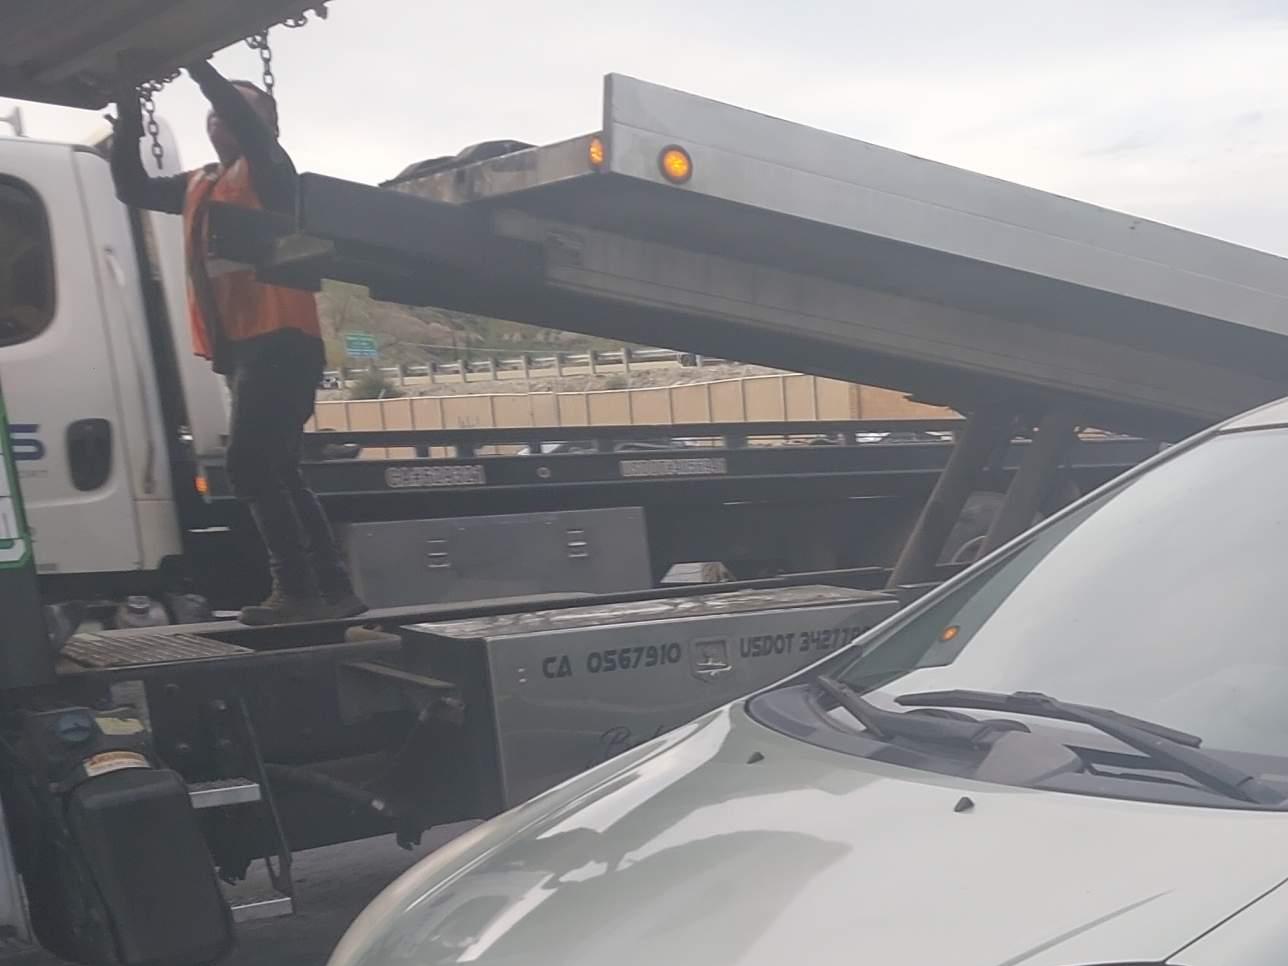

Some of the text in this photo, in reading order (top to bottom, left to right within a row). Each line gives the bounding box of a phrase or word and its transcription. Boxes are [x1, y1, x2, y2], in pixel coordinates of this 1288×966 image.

[542, 642, 682, 679] CA 0567910
[739, 633, 795, 658] USDOT
